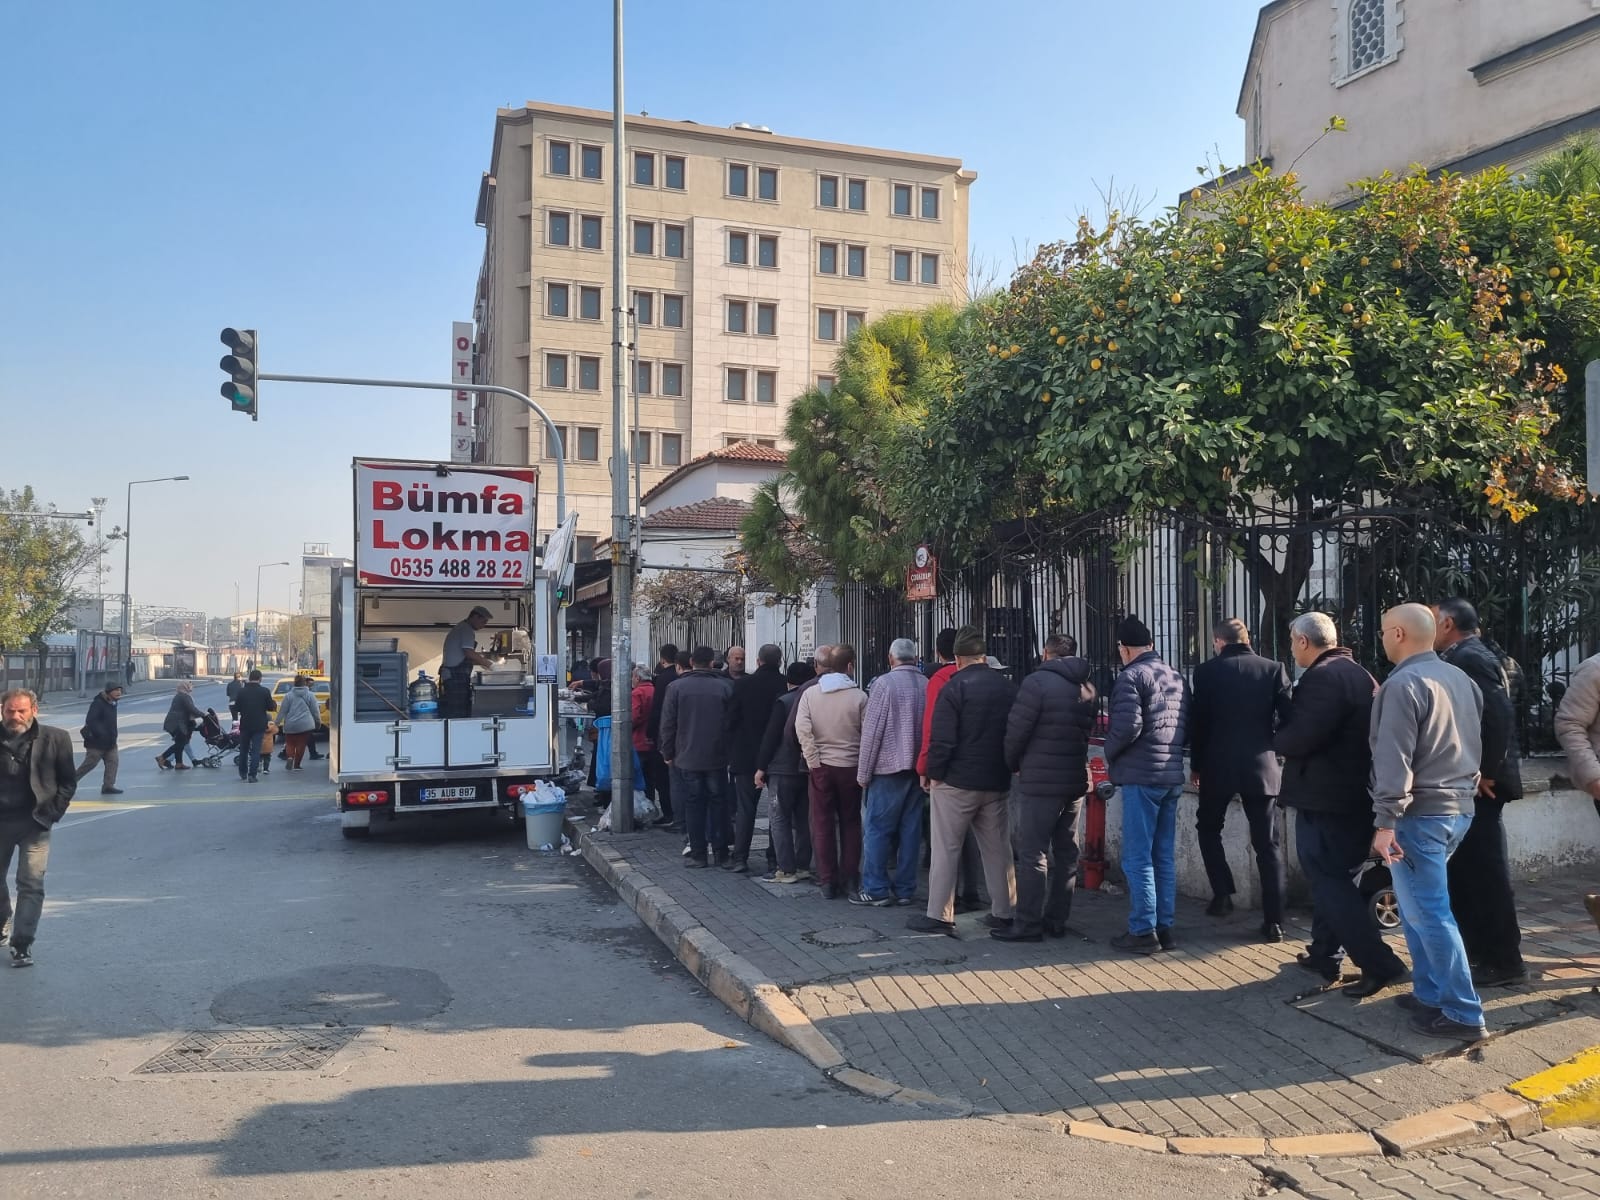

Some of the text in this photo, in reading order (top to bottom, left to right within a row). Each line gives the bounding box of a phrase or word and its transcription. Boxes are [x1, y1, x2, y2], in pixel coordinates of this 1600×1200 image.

[456, 337, 470, 426] OTEL
[372, 480, 524, 515] Bümfa
[372, 519, 530, 552] Lokma
[390, 557, 522, 578] 0535 488 28 22
[426, 789, 436, 798] 35
[441, 788, 456, 798] AUB
